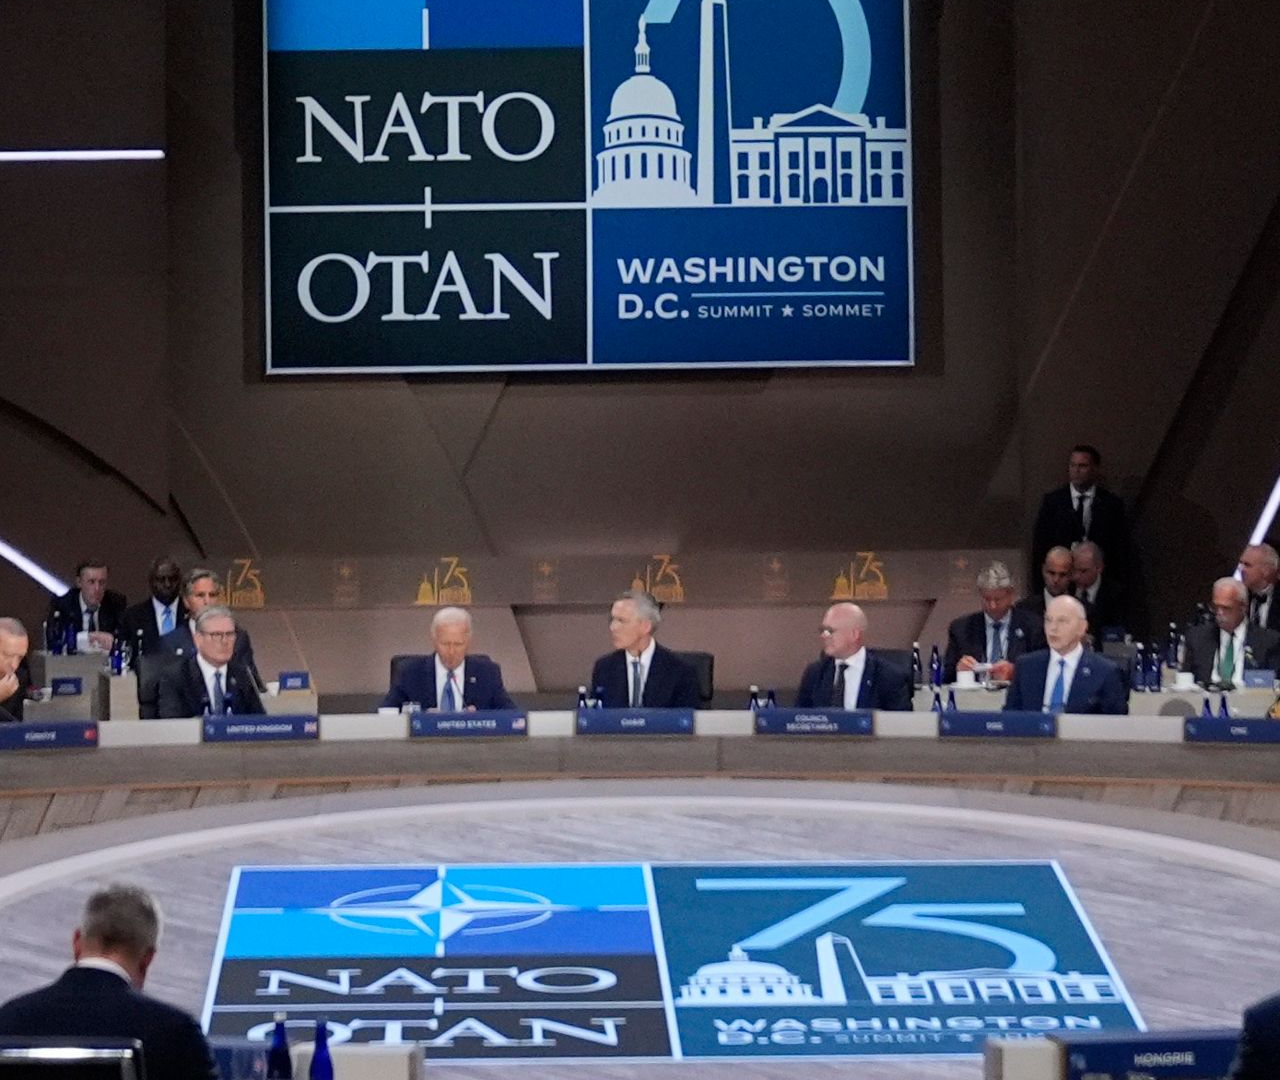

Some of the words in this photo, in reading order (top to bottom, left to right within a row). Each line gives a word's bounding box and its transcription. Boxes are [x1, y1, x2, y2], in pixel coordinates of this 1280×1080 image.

[295, 90, 556, 164] NATO
[616, 255, 886, 284] WASHINGTON
[296, 250, 560, 323] OTAN
[617, 293, 691, 320] D.C.
[697, 305, 773, 319] SUMMIT
[801, 303, 886, 318] SOMMET
[695, 876, 1058, 974] 75
[256, 966, 618, 996] NATO
[246, 1017, 627, 1047] OTAN
[714, 1015, 1103, 1032] WASHINGTON
[1134, 1052, 1195, 1066] HONGRIE
